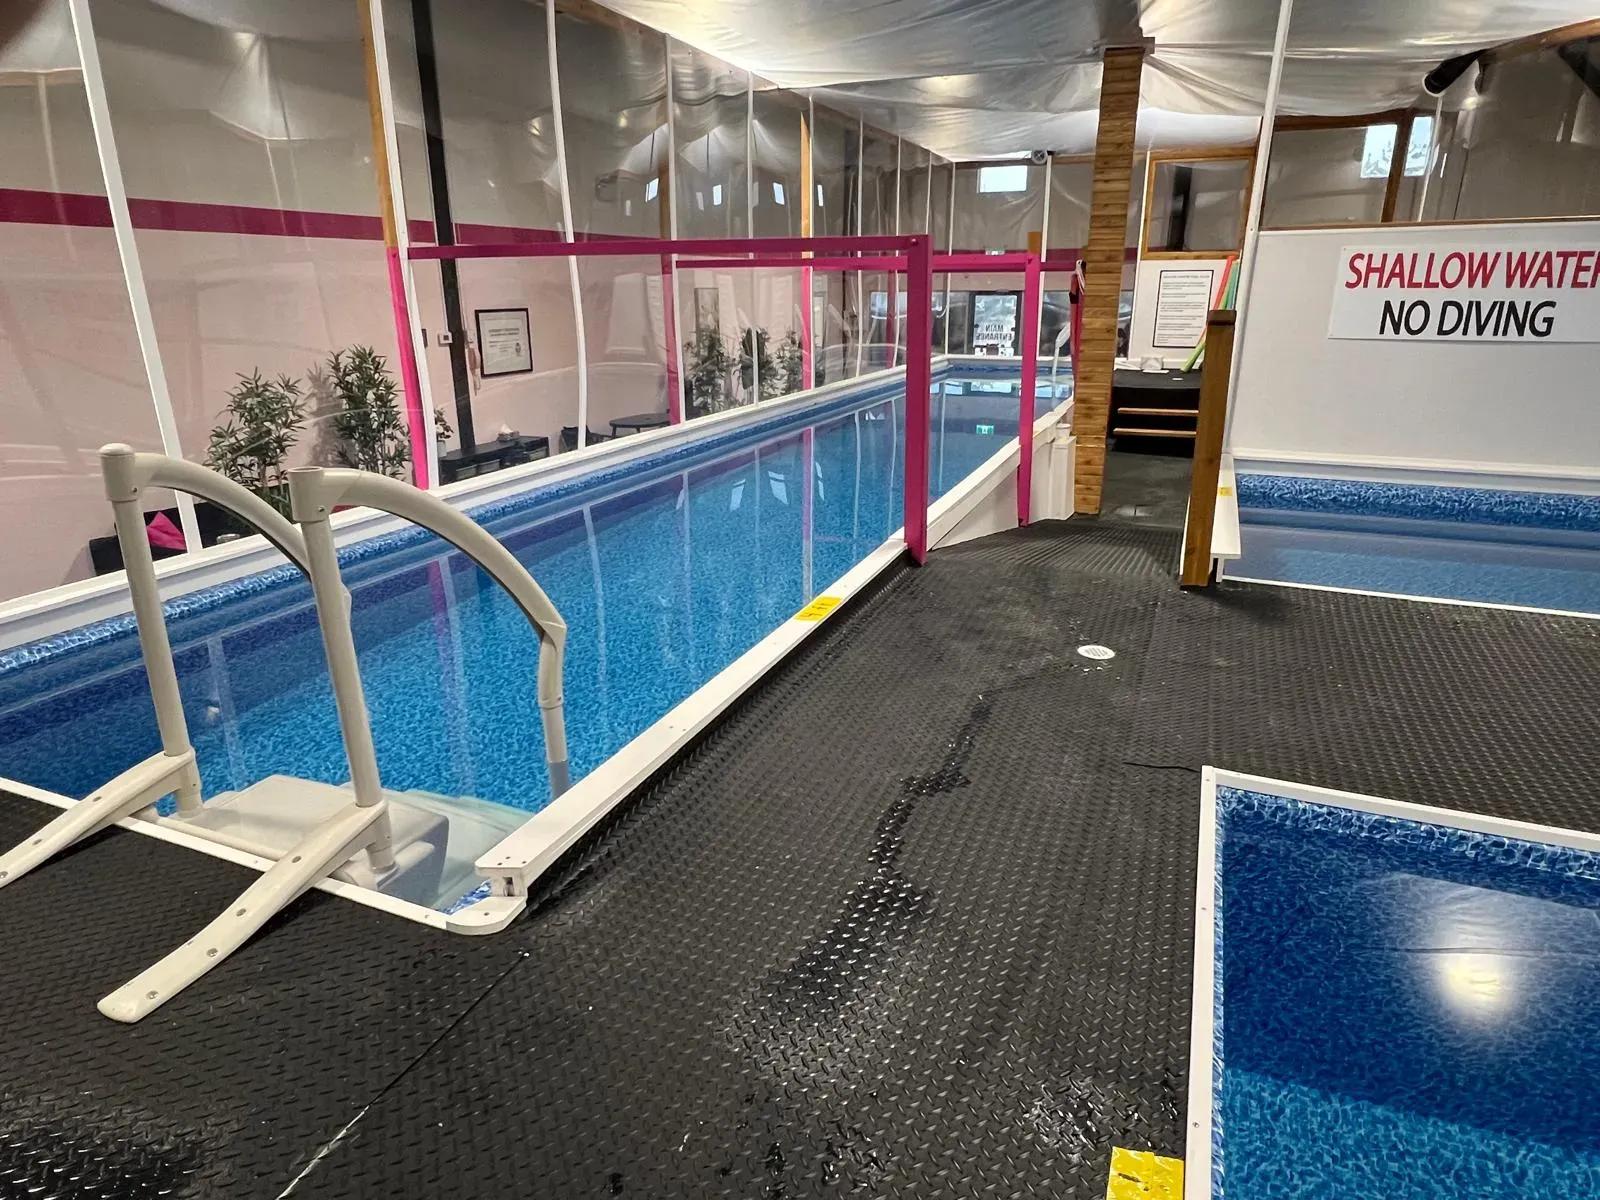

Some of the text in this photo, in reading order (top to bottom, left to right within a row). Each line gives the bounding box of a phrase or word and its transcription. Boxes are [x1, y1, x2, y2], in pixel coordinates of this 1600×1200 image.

[1345, 252, 1501, 289] SHALLOW
[1379, 300, 1557, 337] NO DIVING
